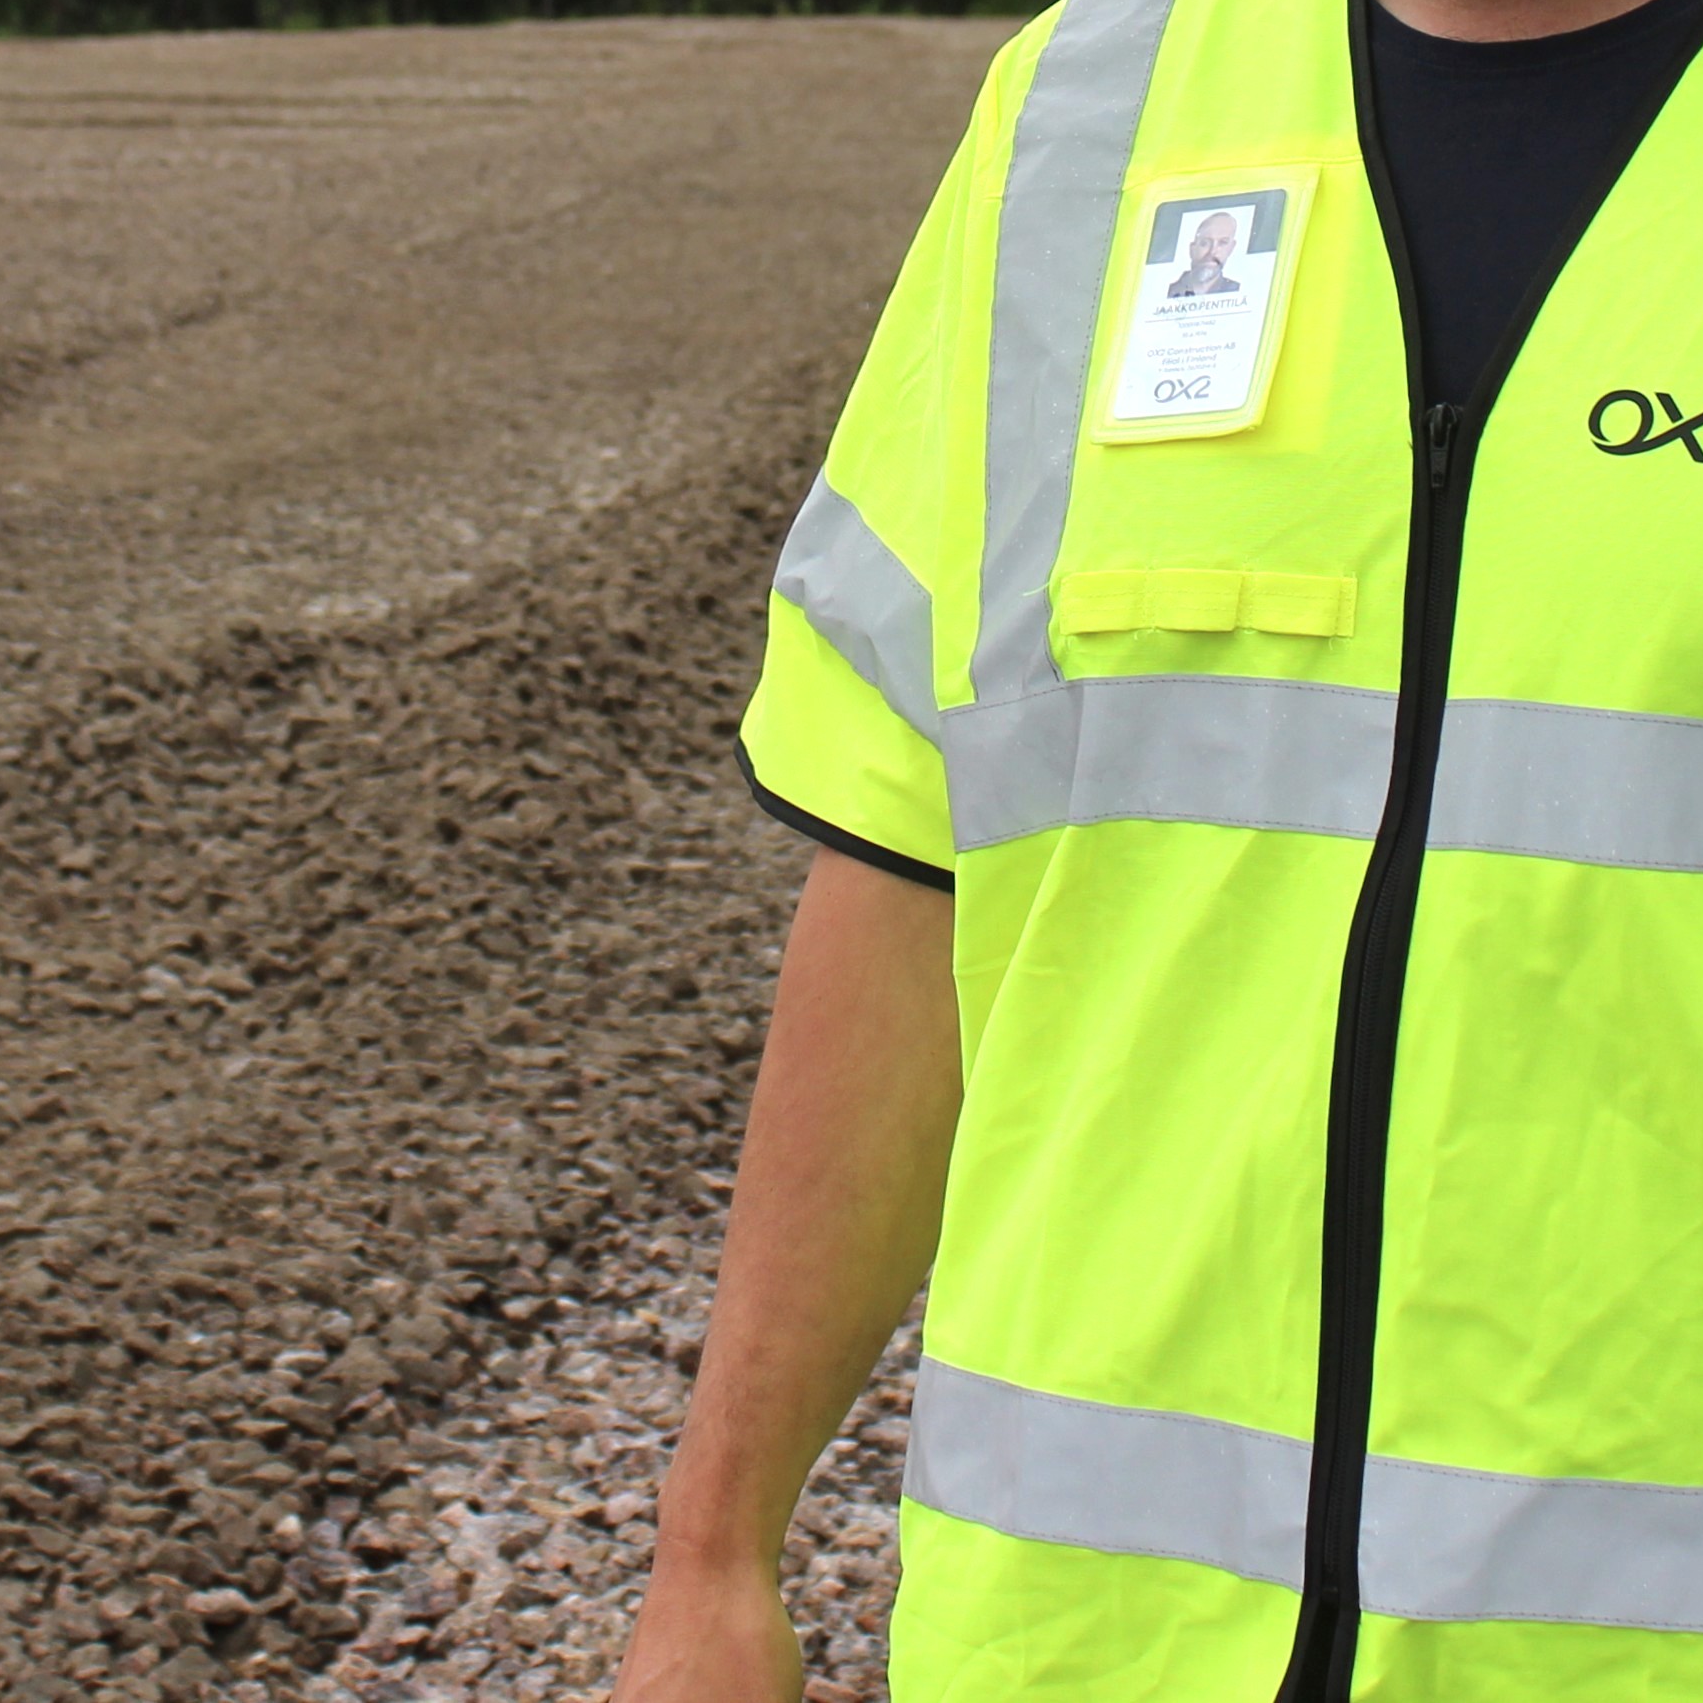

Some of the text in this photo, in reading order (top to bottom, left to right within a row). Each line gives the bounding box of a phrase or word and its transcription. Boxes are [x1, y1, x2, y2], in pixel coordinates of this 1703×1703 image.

[1153, 295, 1248, 316] JAAKKO PENTTILÄ
[1154, 375, 1212, 404] OX2
